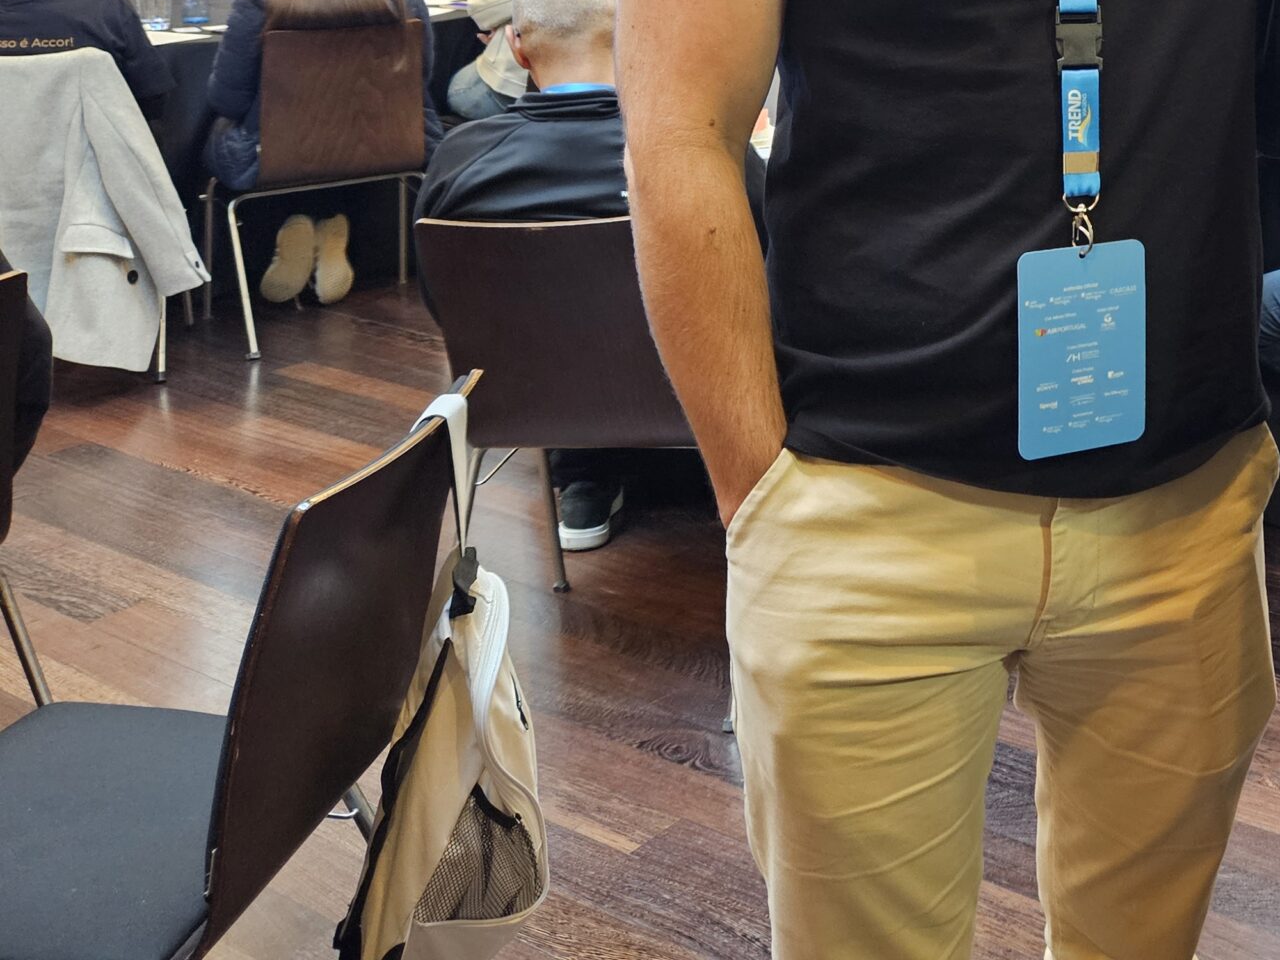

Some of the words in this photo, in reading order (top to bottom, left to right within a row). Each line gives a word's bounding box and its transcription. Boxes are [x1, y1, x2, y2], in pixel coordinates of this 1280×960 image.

[19, 38, 29, 48] é
[31, 37, 75, 48] Accor!
[1068, 89, 1081, 140] TREND
